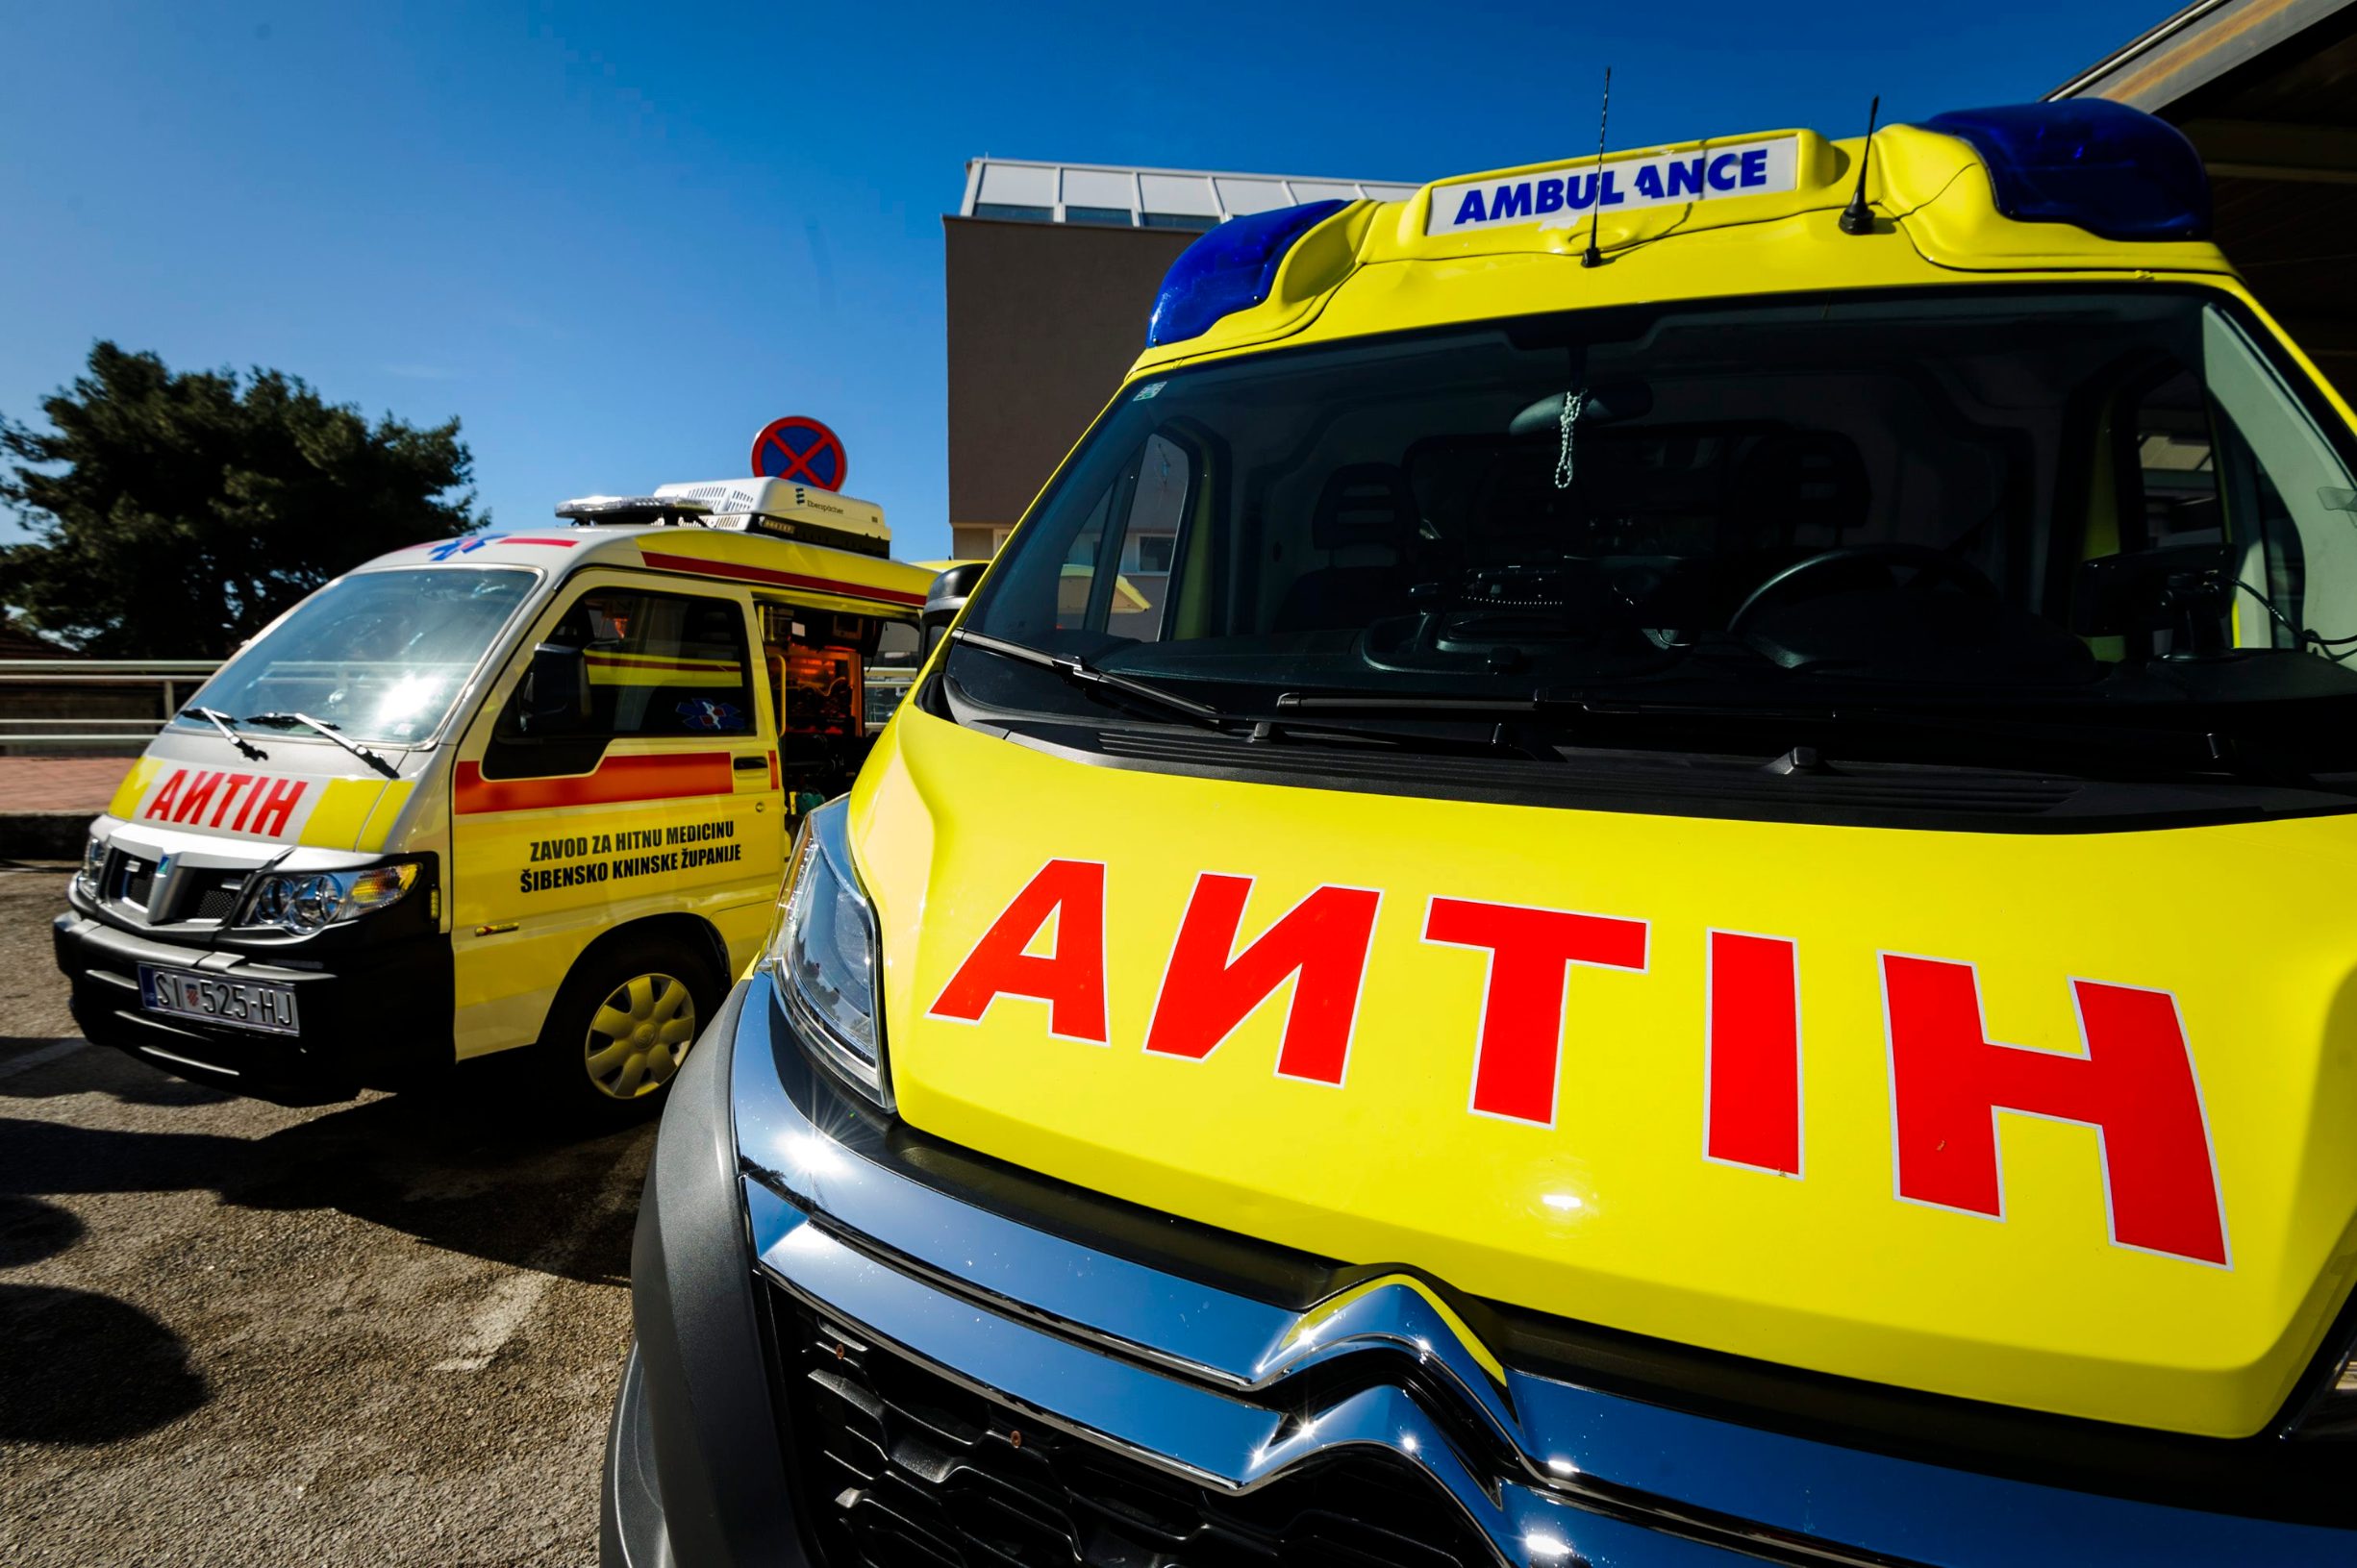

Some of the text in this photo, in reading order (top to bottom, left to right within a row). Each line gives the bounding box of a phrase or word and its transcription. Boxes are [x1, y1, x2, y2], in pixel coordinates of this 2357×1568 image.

[1453, 149, 1768, 225] AMBULANCE
[530, 820, 735, 862] ZAVOD ZA HITNU MEDICINU
[520, 844, 741, 893] ŠIBENSKO KNINSKE ŽUPANIJE
[155, 971, 293, 1026] SI 525-HJ
